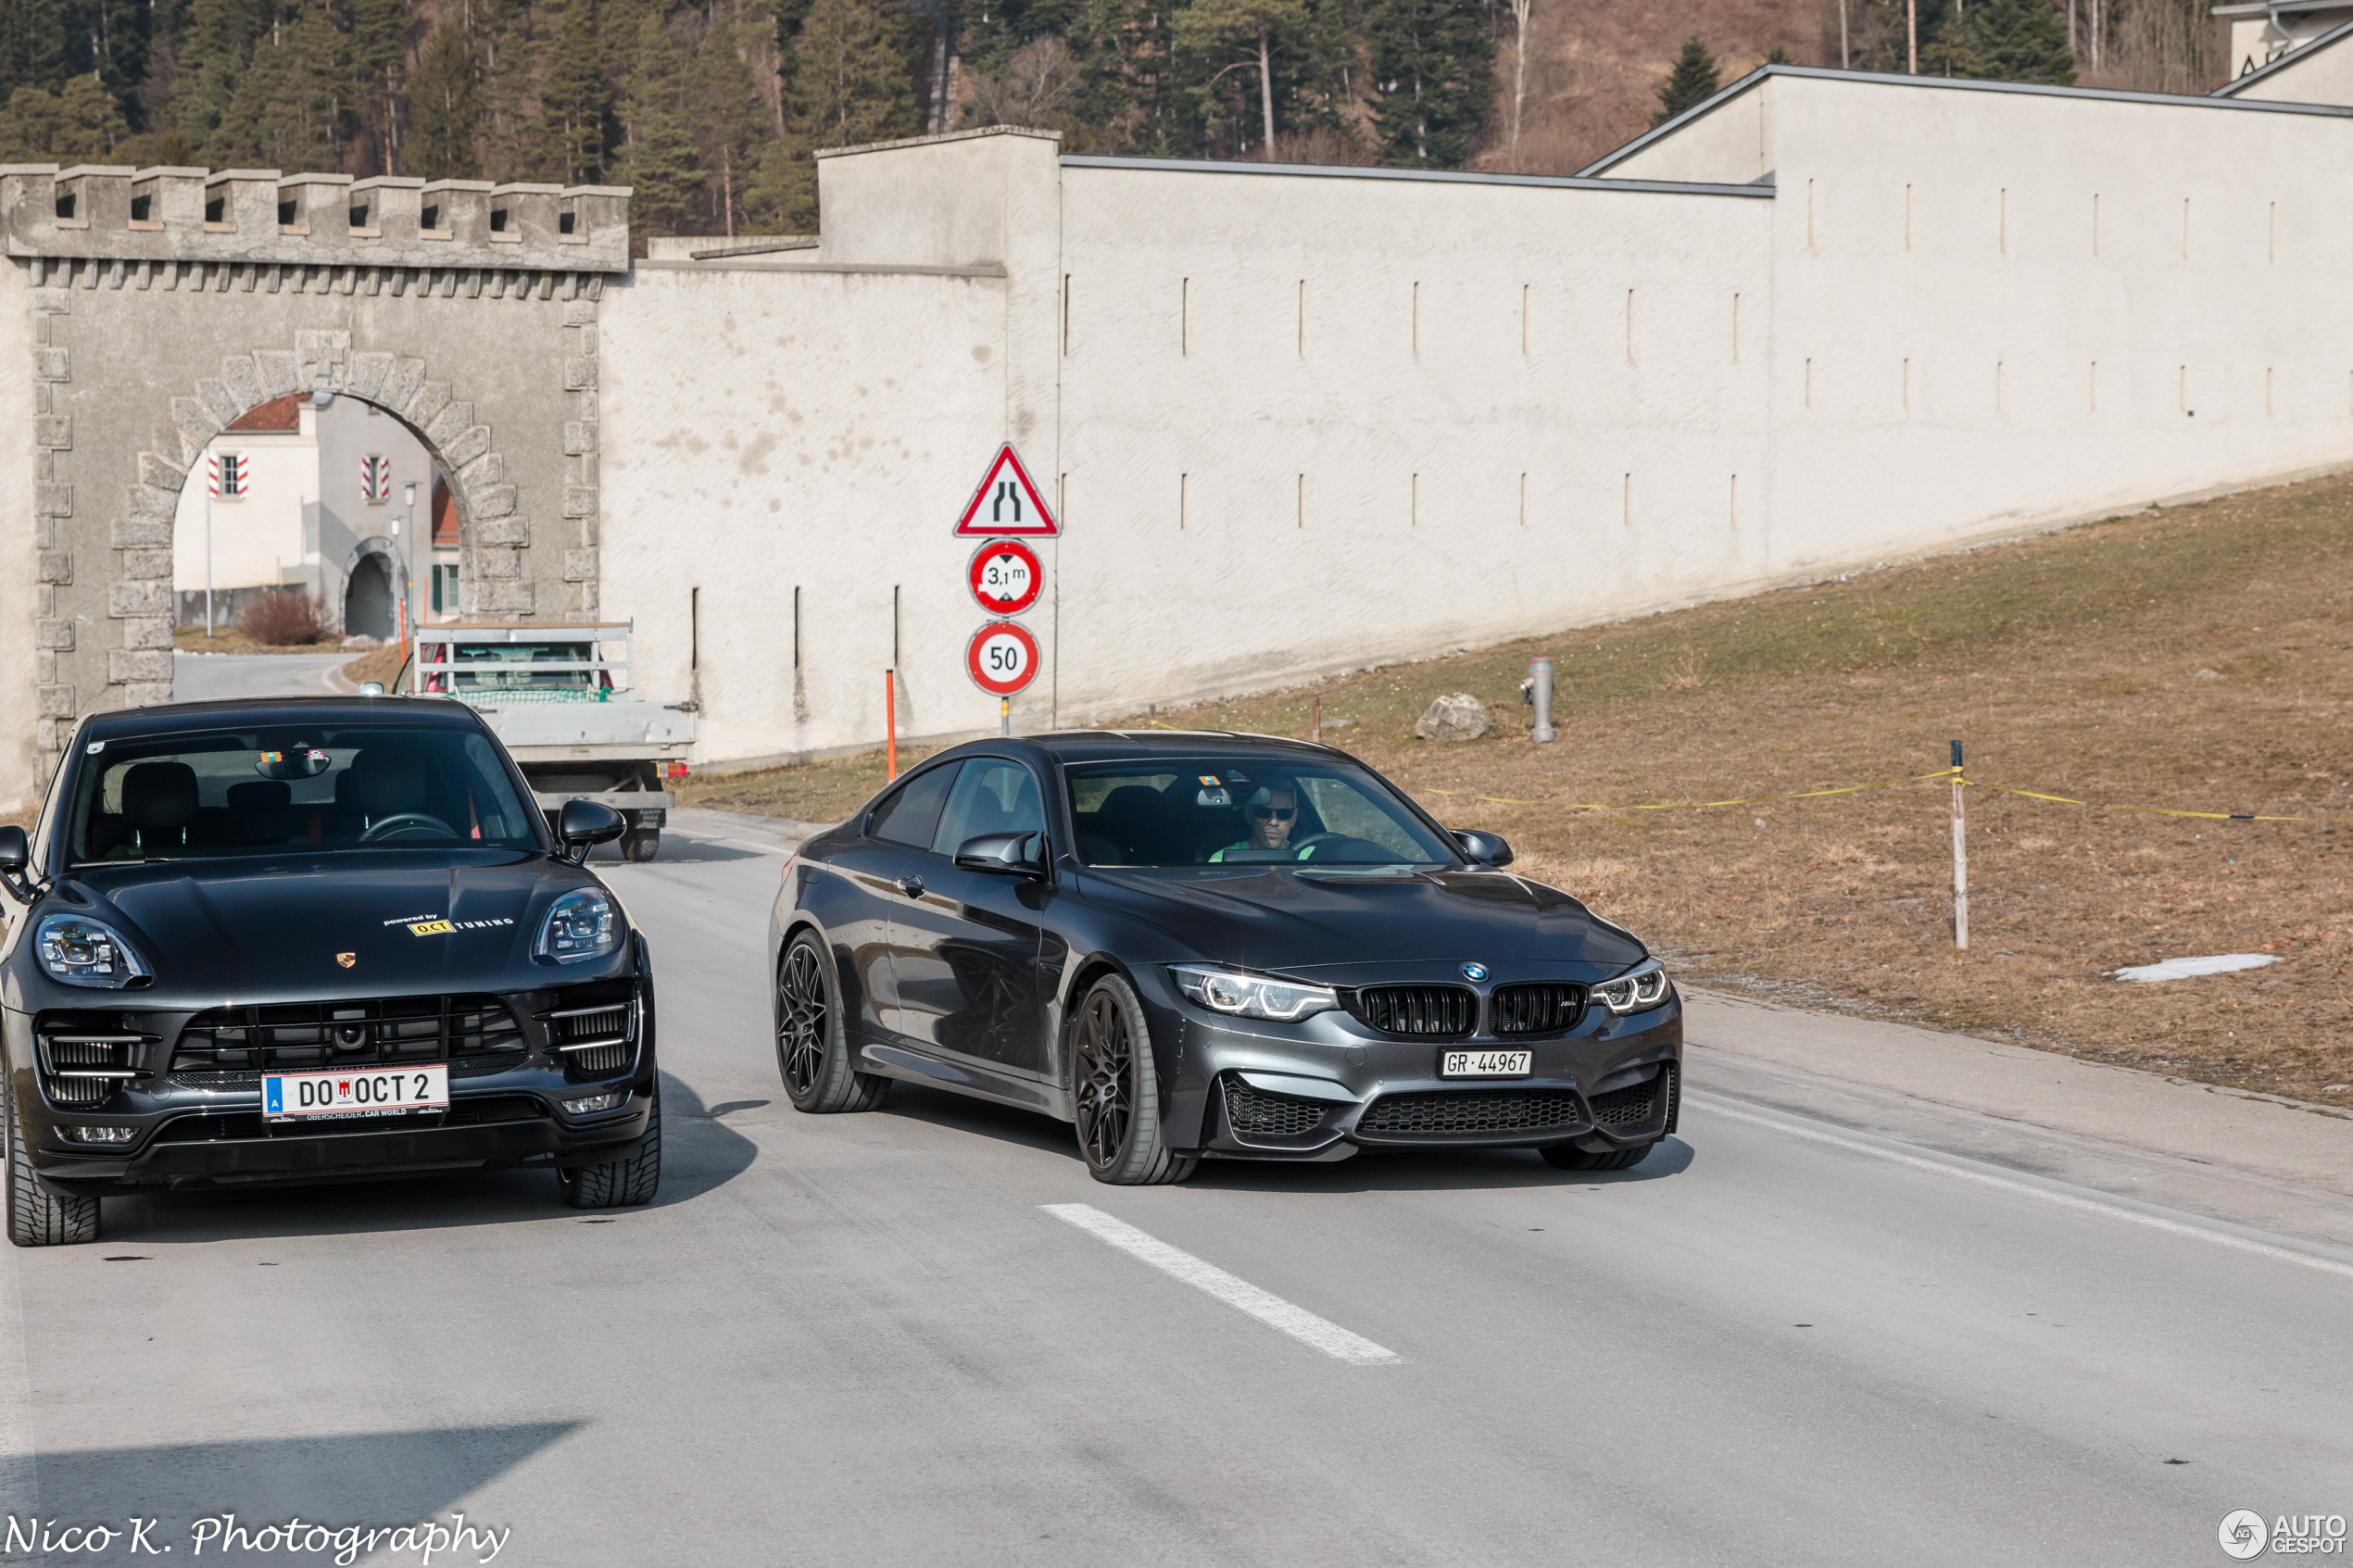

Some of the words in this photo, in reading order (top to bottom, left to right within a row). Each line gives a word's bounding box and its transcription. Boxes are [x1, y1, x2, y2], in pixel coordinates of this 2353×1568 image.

[990, 646, 1017, 671] 50
[384, 915, 424, 926] powered
[455, 918, 514, 930] TUNING
[299, 1080, 333, 1107] DO
[355, 1075, 405, 1103] OCT
[414, 1073, 429, 1100] 2
[271, 1099, 279, 1108] A
[381, 1109, 407, 1117] WORLD
